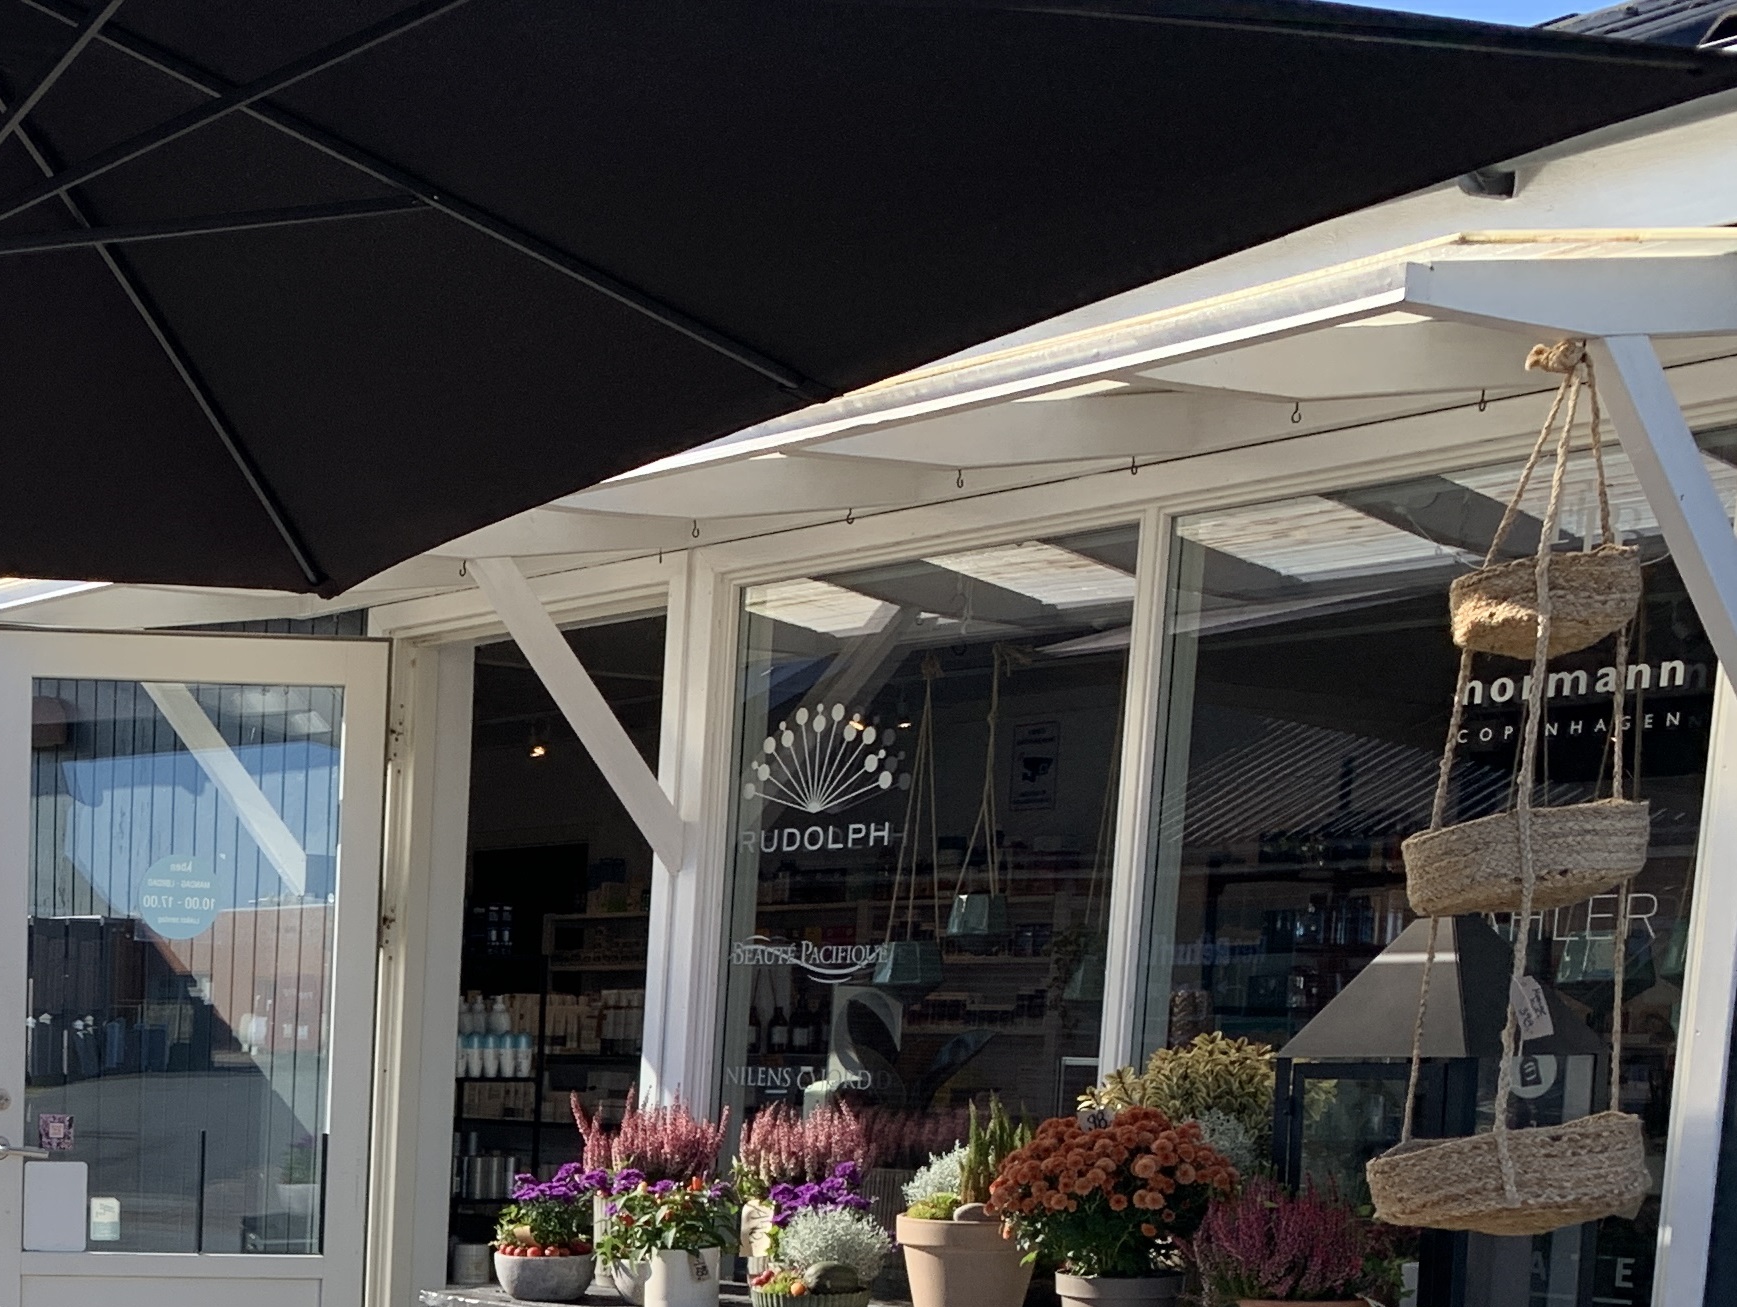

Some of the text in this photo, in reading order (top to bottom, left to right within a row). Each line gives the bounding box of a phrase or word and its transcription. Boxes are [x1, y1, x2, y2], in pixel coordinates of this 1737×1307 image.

[1457, 711, 1681, 744] COPNHAGEN
[738, 821, 890, 855] RUDOLPH
[1481, 893, 1658, 942] HLER
[801, 940, 889, 966] PACIFIQUE
[724, 1066, 792, 1088] NILENS
